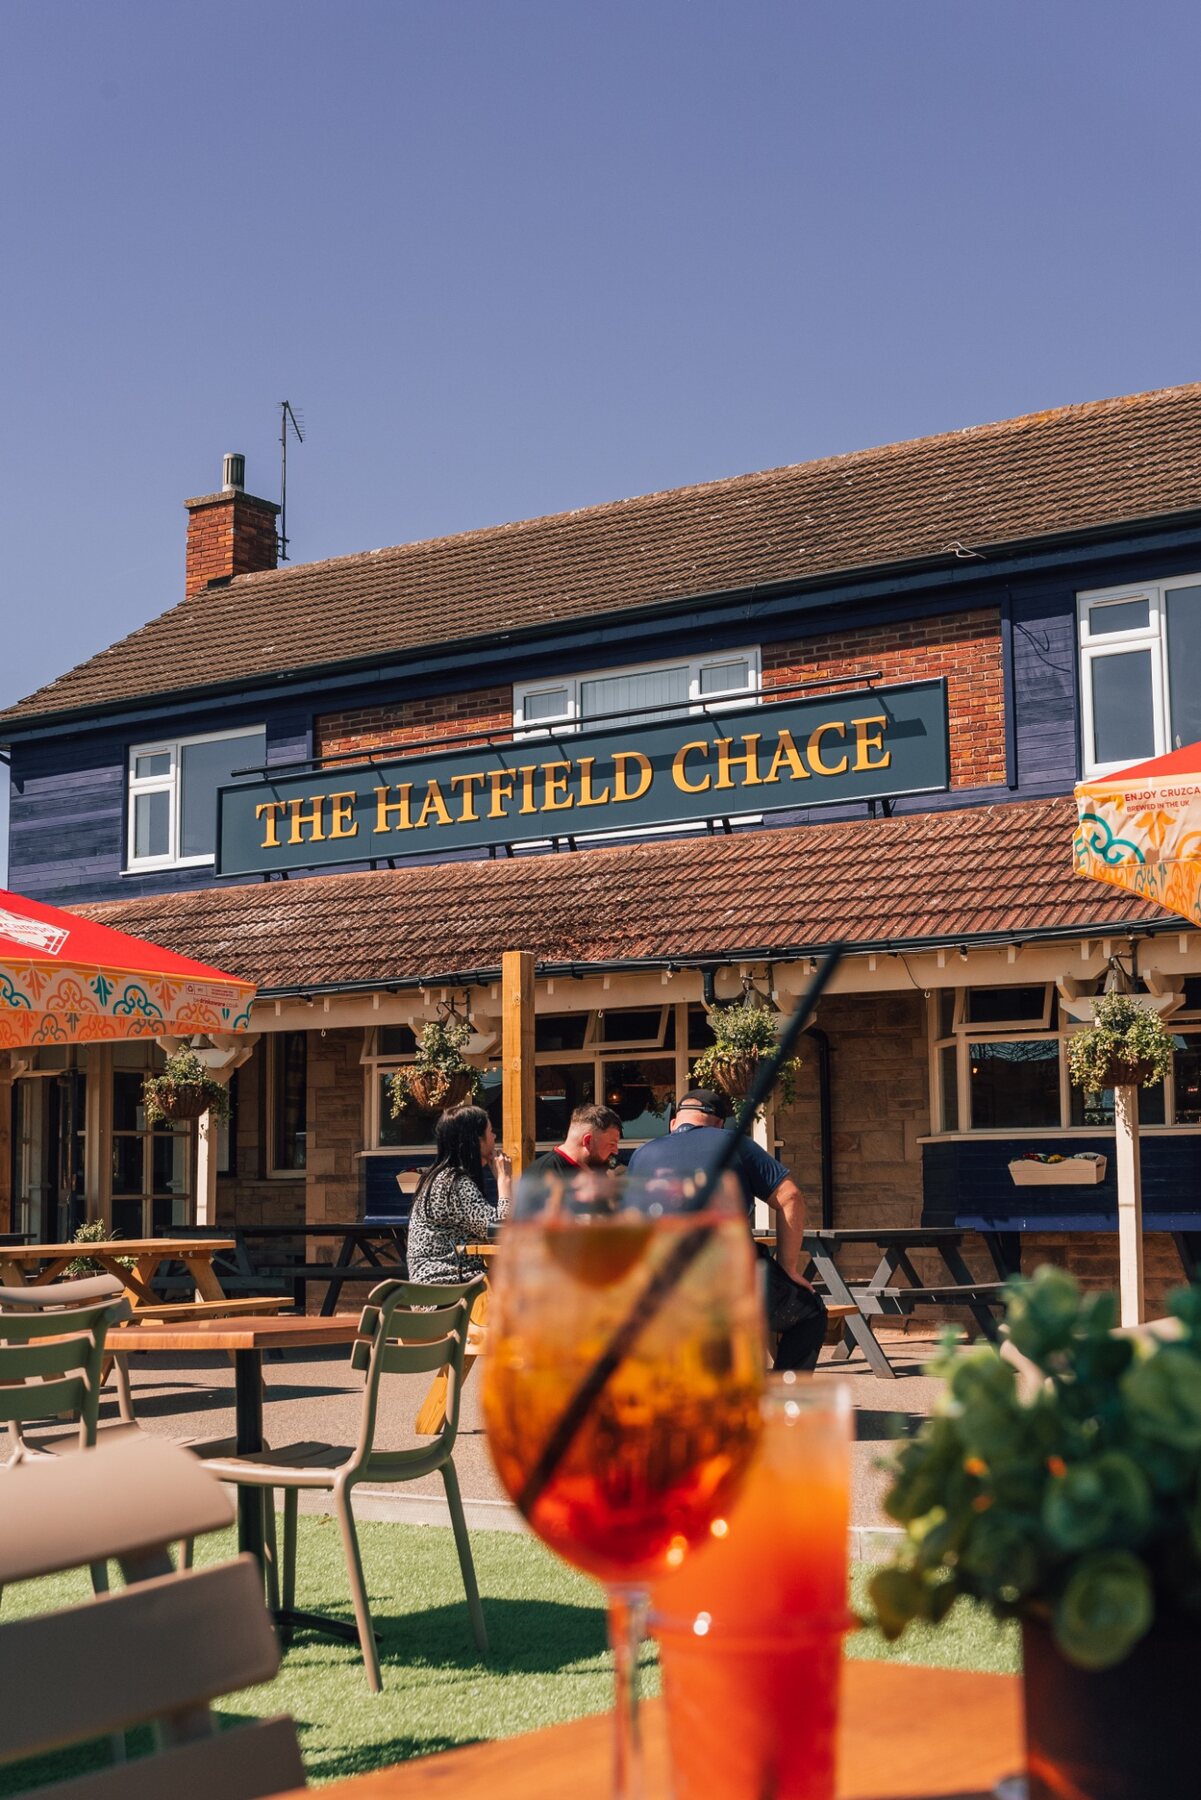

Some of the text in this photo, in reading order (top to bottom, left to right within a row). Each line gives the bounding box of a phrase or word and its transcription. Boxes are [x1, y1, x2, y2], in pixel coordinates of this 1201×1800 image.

[256, 715, 892, 849] THE HATFIELD CHACE
[1125, 791, 1157, 802] ENJOY
[1127, 803, 1156, 812] BREWED
[1165, 801, 1180, 809] THE
[1180, 800, 1190, 808] UK
